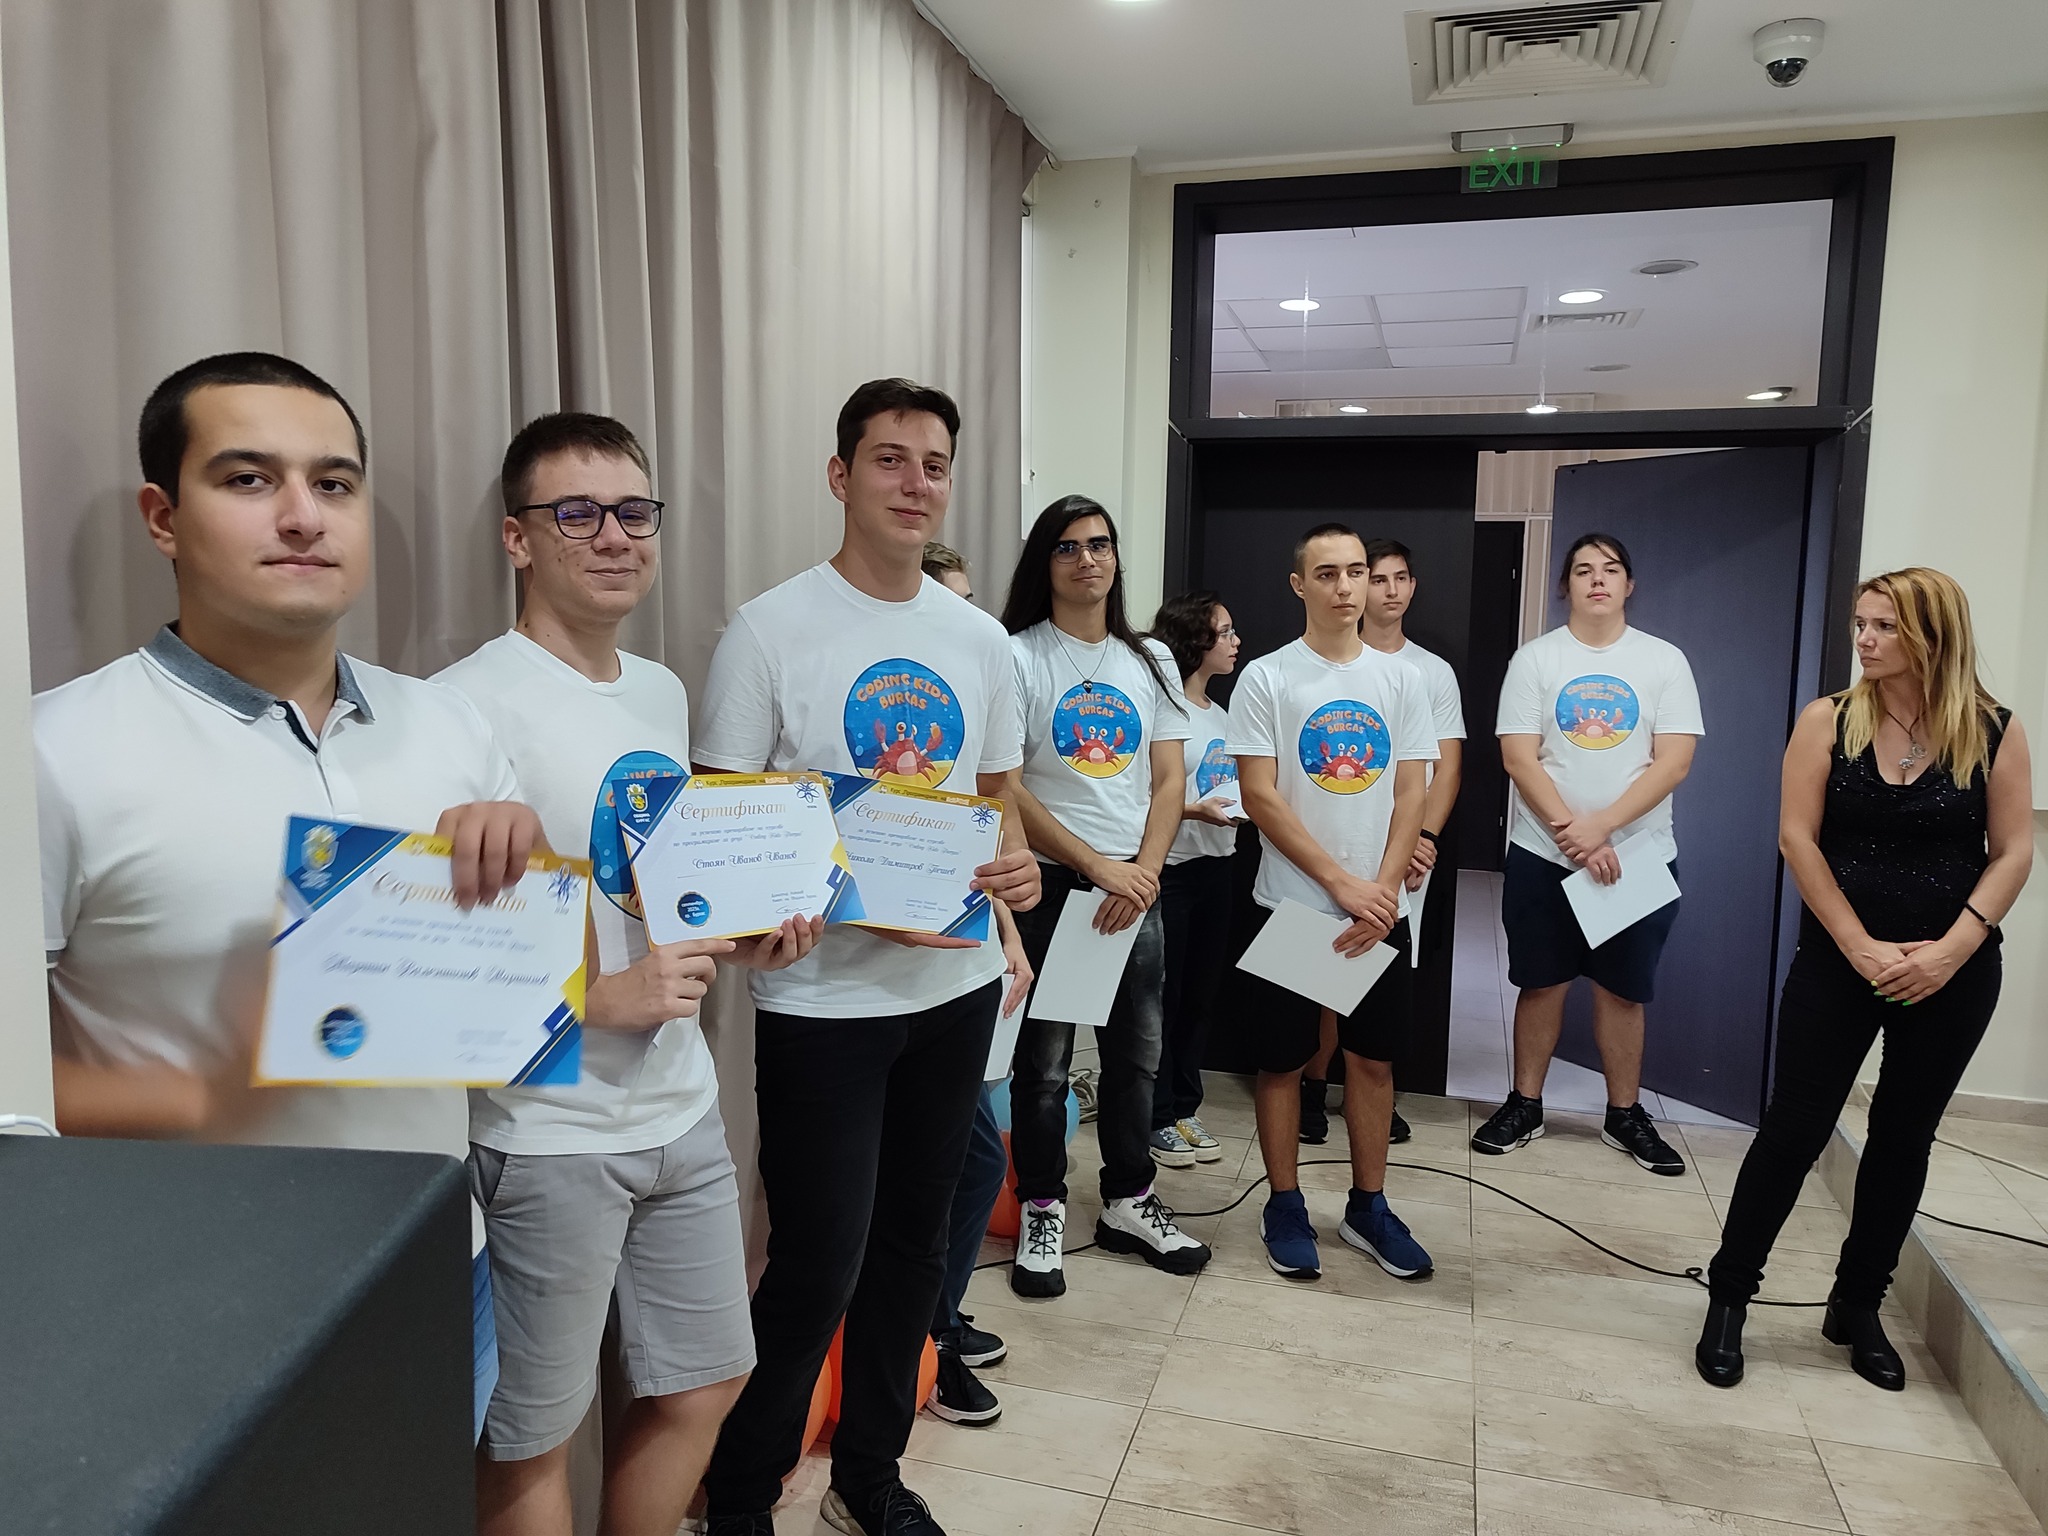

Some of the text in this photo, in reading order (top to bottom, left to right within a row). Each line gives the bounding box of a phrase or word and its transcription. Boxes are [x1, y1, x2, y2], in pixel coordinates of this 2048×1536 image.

[1468, 156, 1543, 190] EXIT
[856, 673, 950, 706] CODING KIDS
[879, 692, 928, 711] BURGAS
[1062, 692, 1132, 715] CODING KIDS
[1078, 705, 1115, 718] BURGAS
[1310, 710, 1381, 730] CODING KIDS
[1327, 723, 1365, 734] BURGAS
[674, 800, 787, 822] Сертификат
[852, 800, 957, 832] Сертификат
[692, 850, 798, 869] Стоян Иванов Иванов
